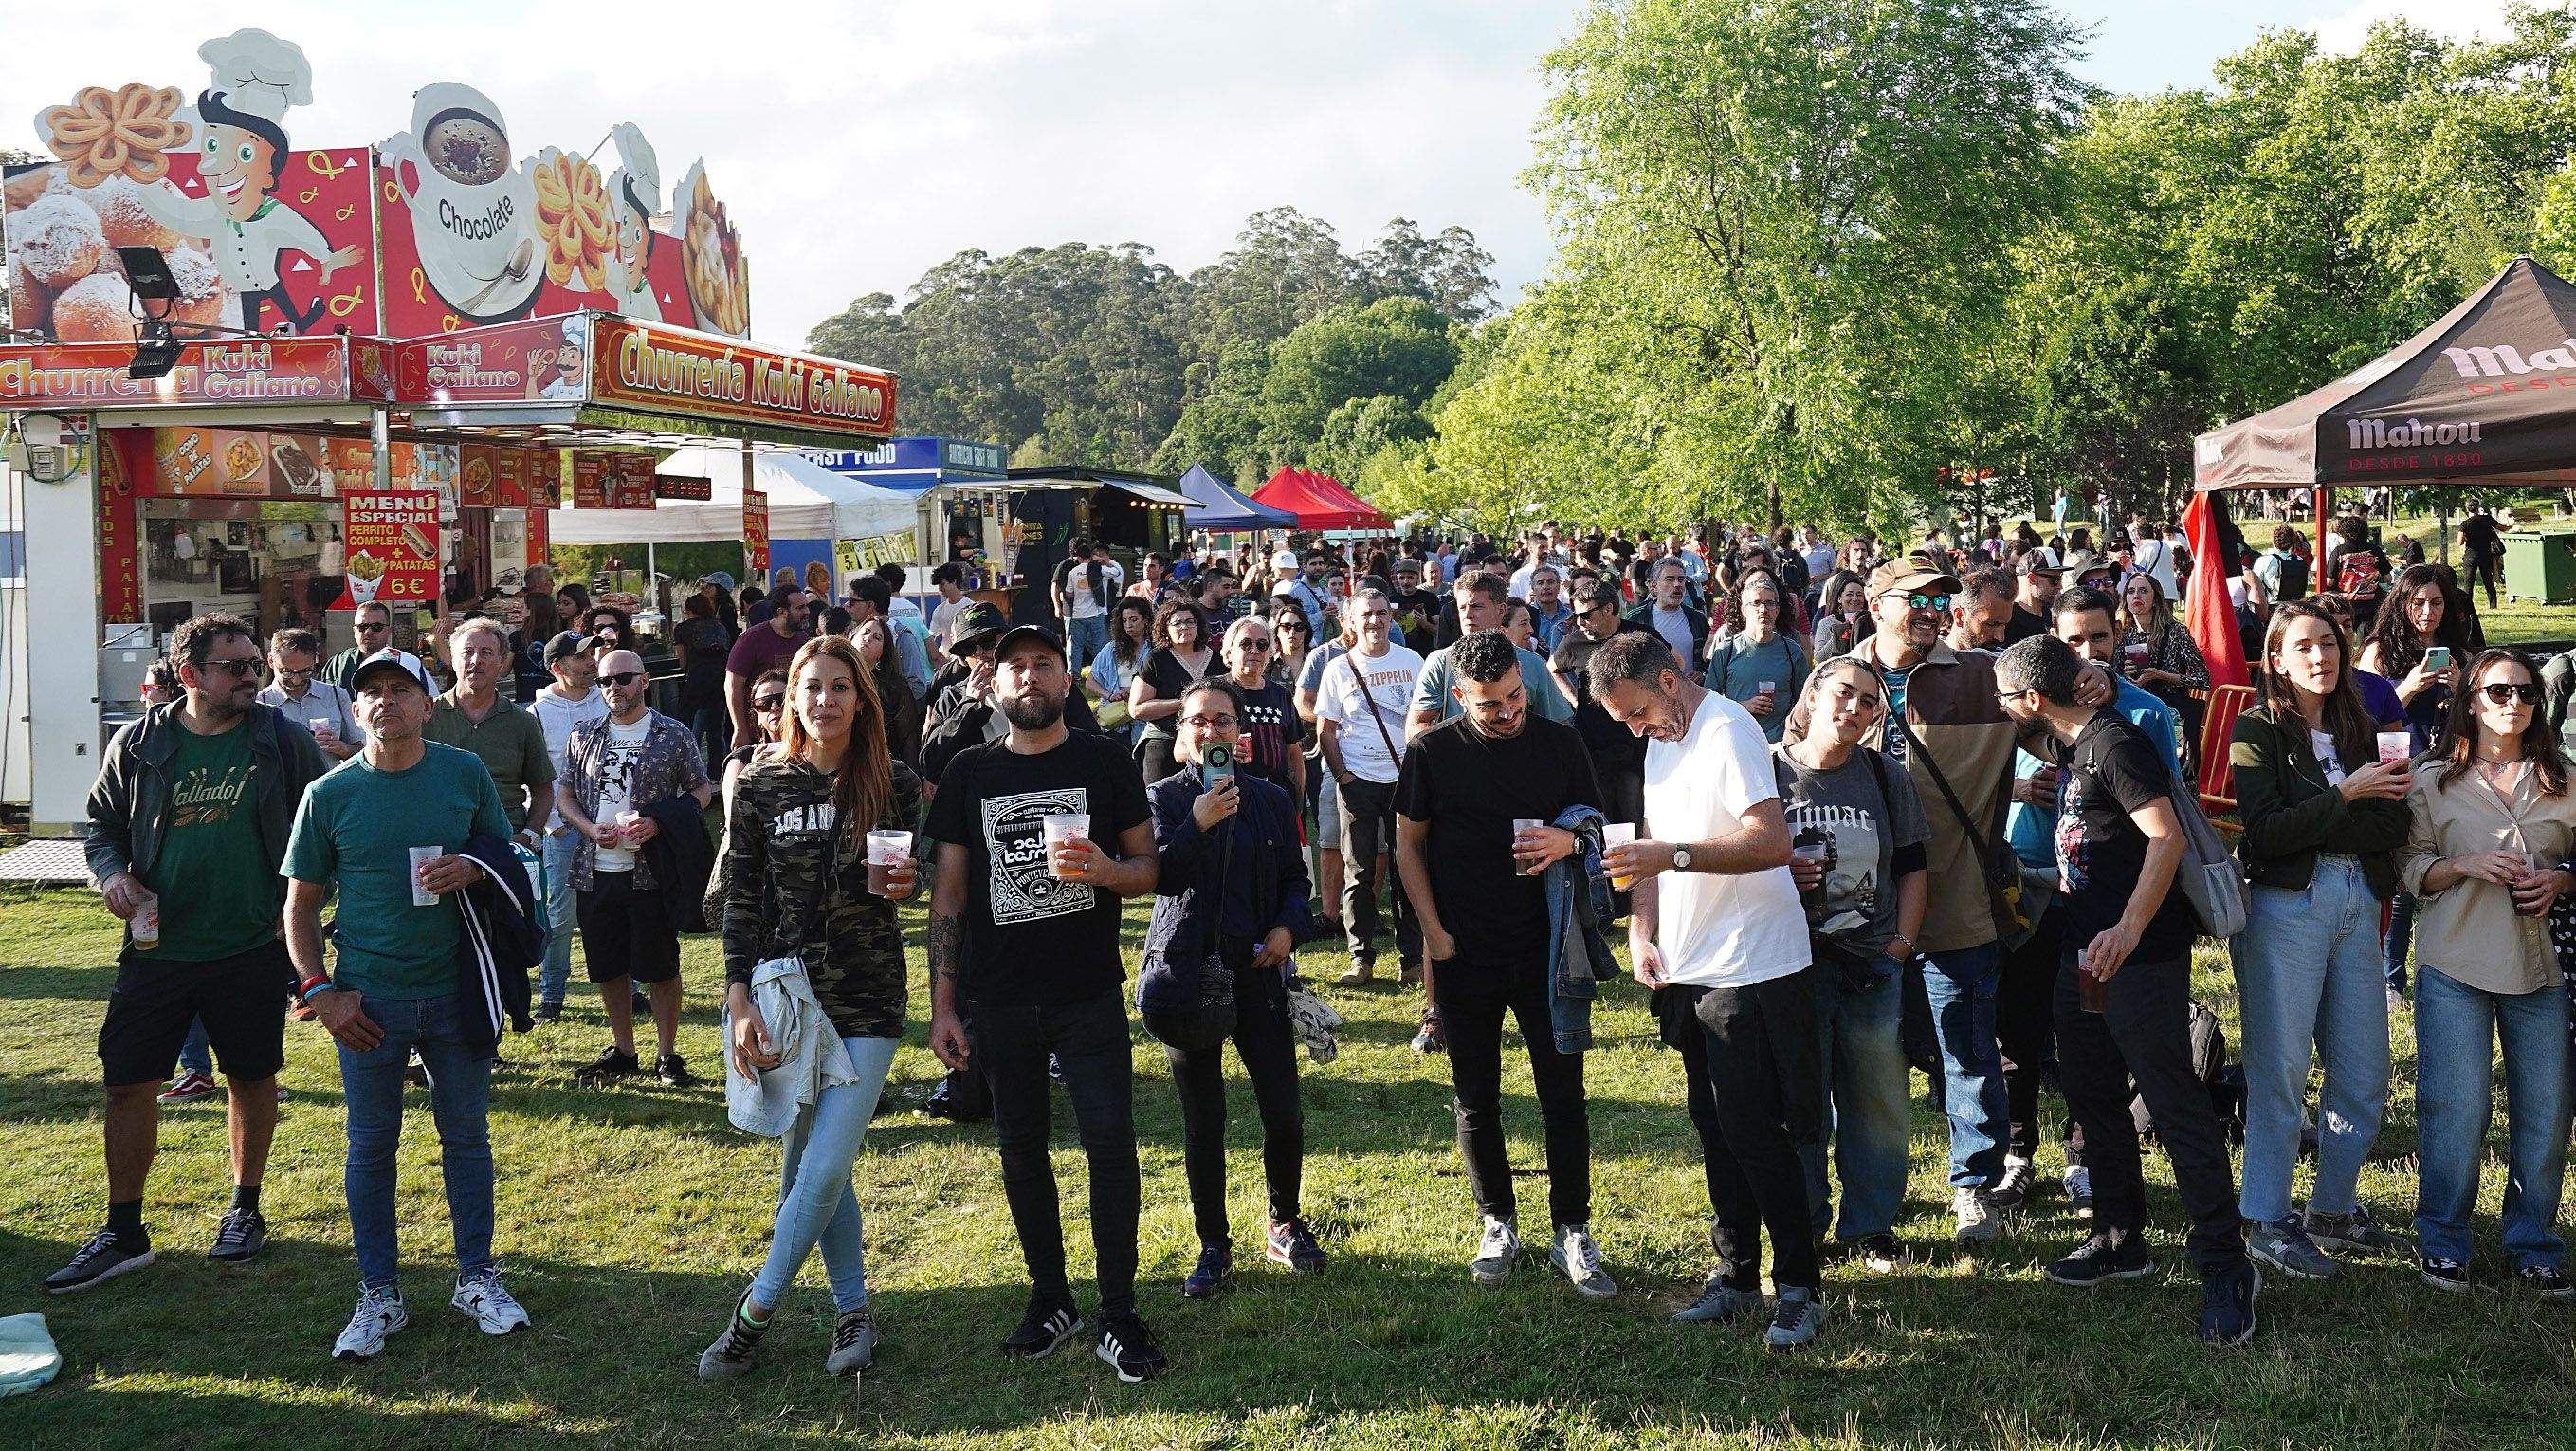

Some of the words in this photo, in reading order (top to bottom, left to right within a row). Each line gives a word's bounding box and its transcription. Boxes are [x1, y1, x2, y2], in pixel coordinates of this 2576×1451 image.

[439, 195, 514, 241] Chocolate
[203, 343, 274, 372] Kuki
[427, 343, 482, 366] Kuki
[2441, 338, 2576, 377] Ma
[203, 371, 322, 399] Galiano
[427, 366, 521, 388] Galiano
[618, 327, 746, 402] Churrería
[751, 356, 804, 411] Kuki
[808, 368, 883, 421] Galiano
[177, 432, 199, 457] CONO
[2347, 418, 2482, 450] Mahou
[2348, 454, 2420, 472] DESDE
[2430, 452, 2482, 468] 1890
[349, 493, 437, 510] MENÚ
[349, 511, 437, 523] ESPECIAL
[349, 524, 394, 535] PERRITO
[349, 536, 407, 546] COMPLETO
[389, 560, 437, 571] PATATAS
[1369, 670, 1412, 687] ZEPPELIN
[1783, 799, 1873, 836] Tupac
